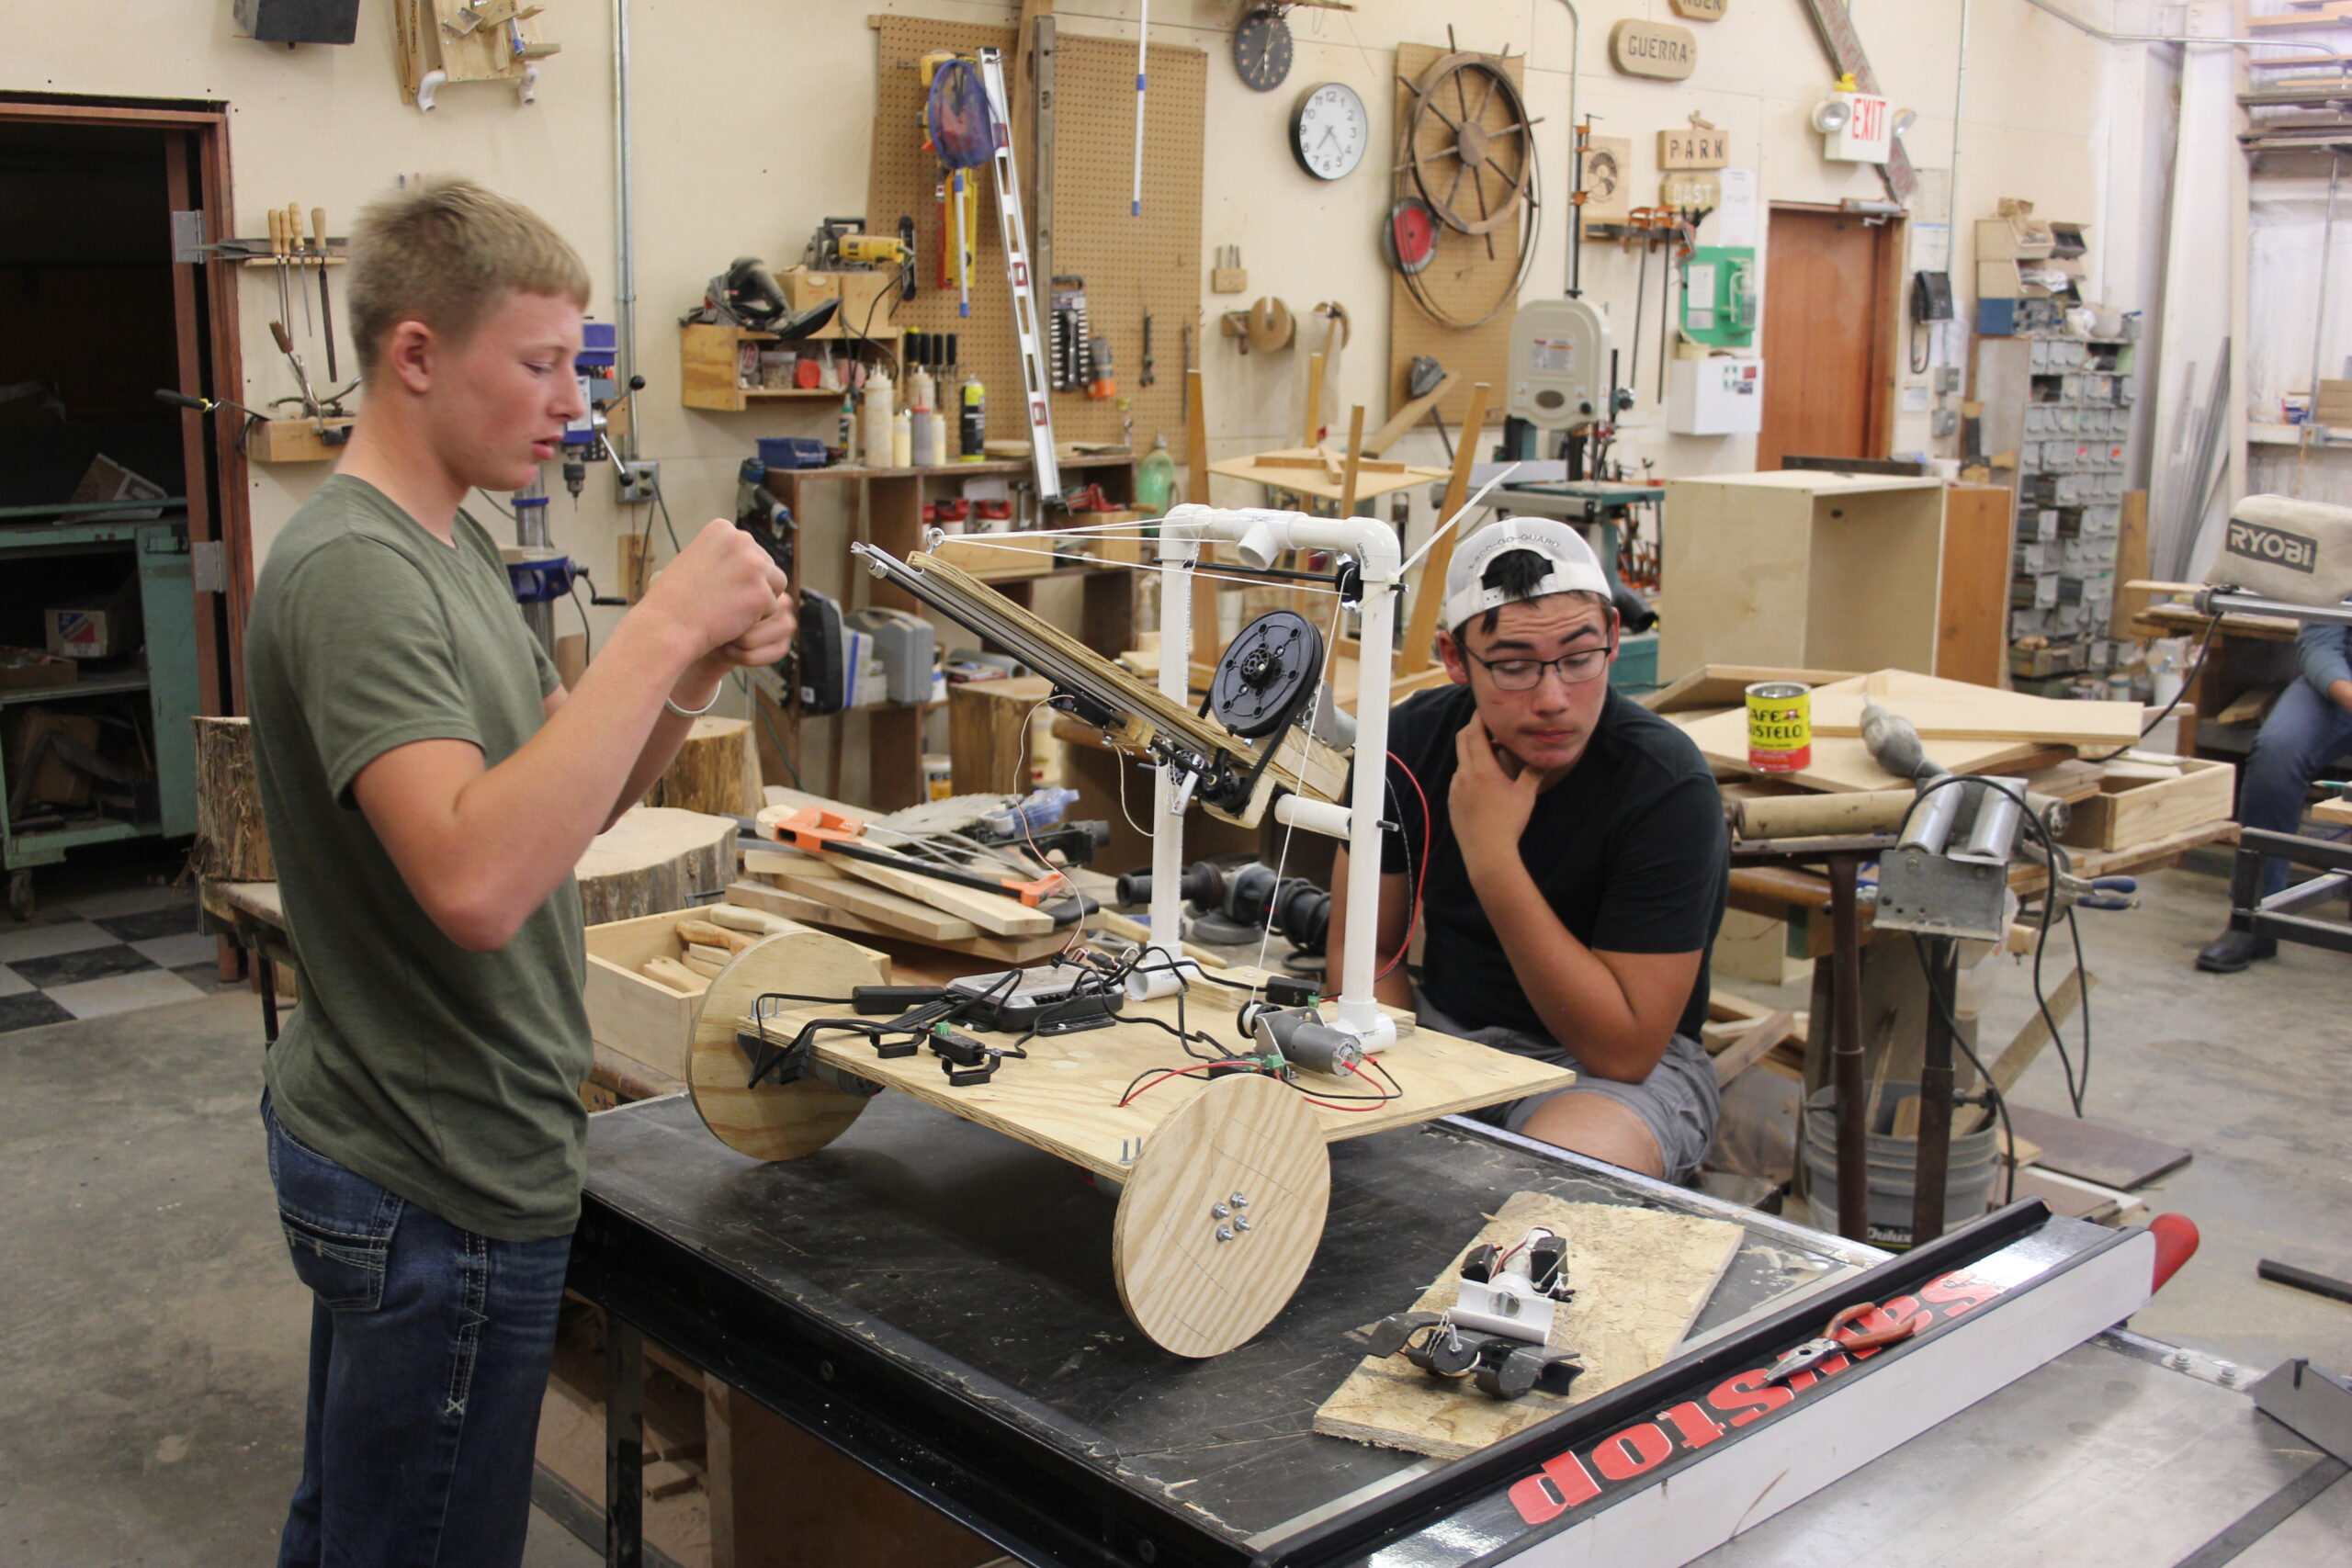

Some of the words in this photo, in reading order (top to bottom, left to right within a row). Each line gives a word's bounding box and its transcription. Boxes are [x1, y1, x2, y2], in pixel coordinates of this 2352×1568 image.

[1627, 35, 1688, 63] GUERRA
[1315, 96, 1322, 106] 11
[1325, 91, 1336, 102] 12
[1305, 108, 1315, 119] 10
[1347, 110, 1353, 121] 2
[1852, 98, 1886, 141] EXIT
[1300, 125, 1306, 135] 9
[1351, 128, 1356, 138] 3
[1302, 142, 1309, 152] 8
[1345, 145, 1351, 154] 4
[1669, 139, 1724, 158] PARK
[1313, 155, 1319, 166] 7
[1323, 161, 1329, 170] 6
[1336, 157, 1342, 167] 5
[2230, 525, 2312, 566] RYOBI
[1749, 709, 1781, 723] AFE
[1748, 725, 1802, 739] USTELO
